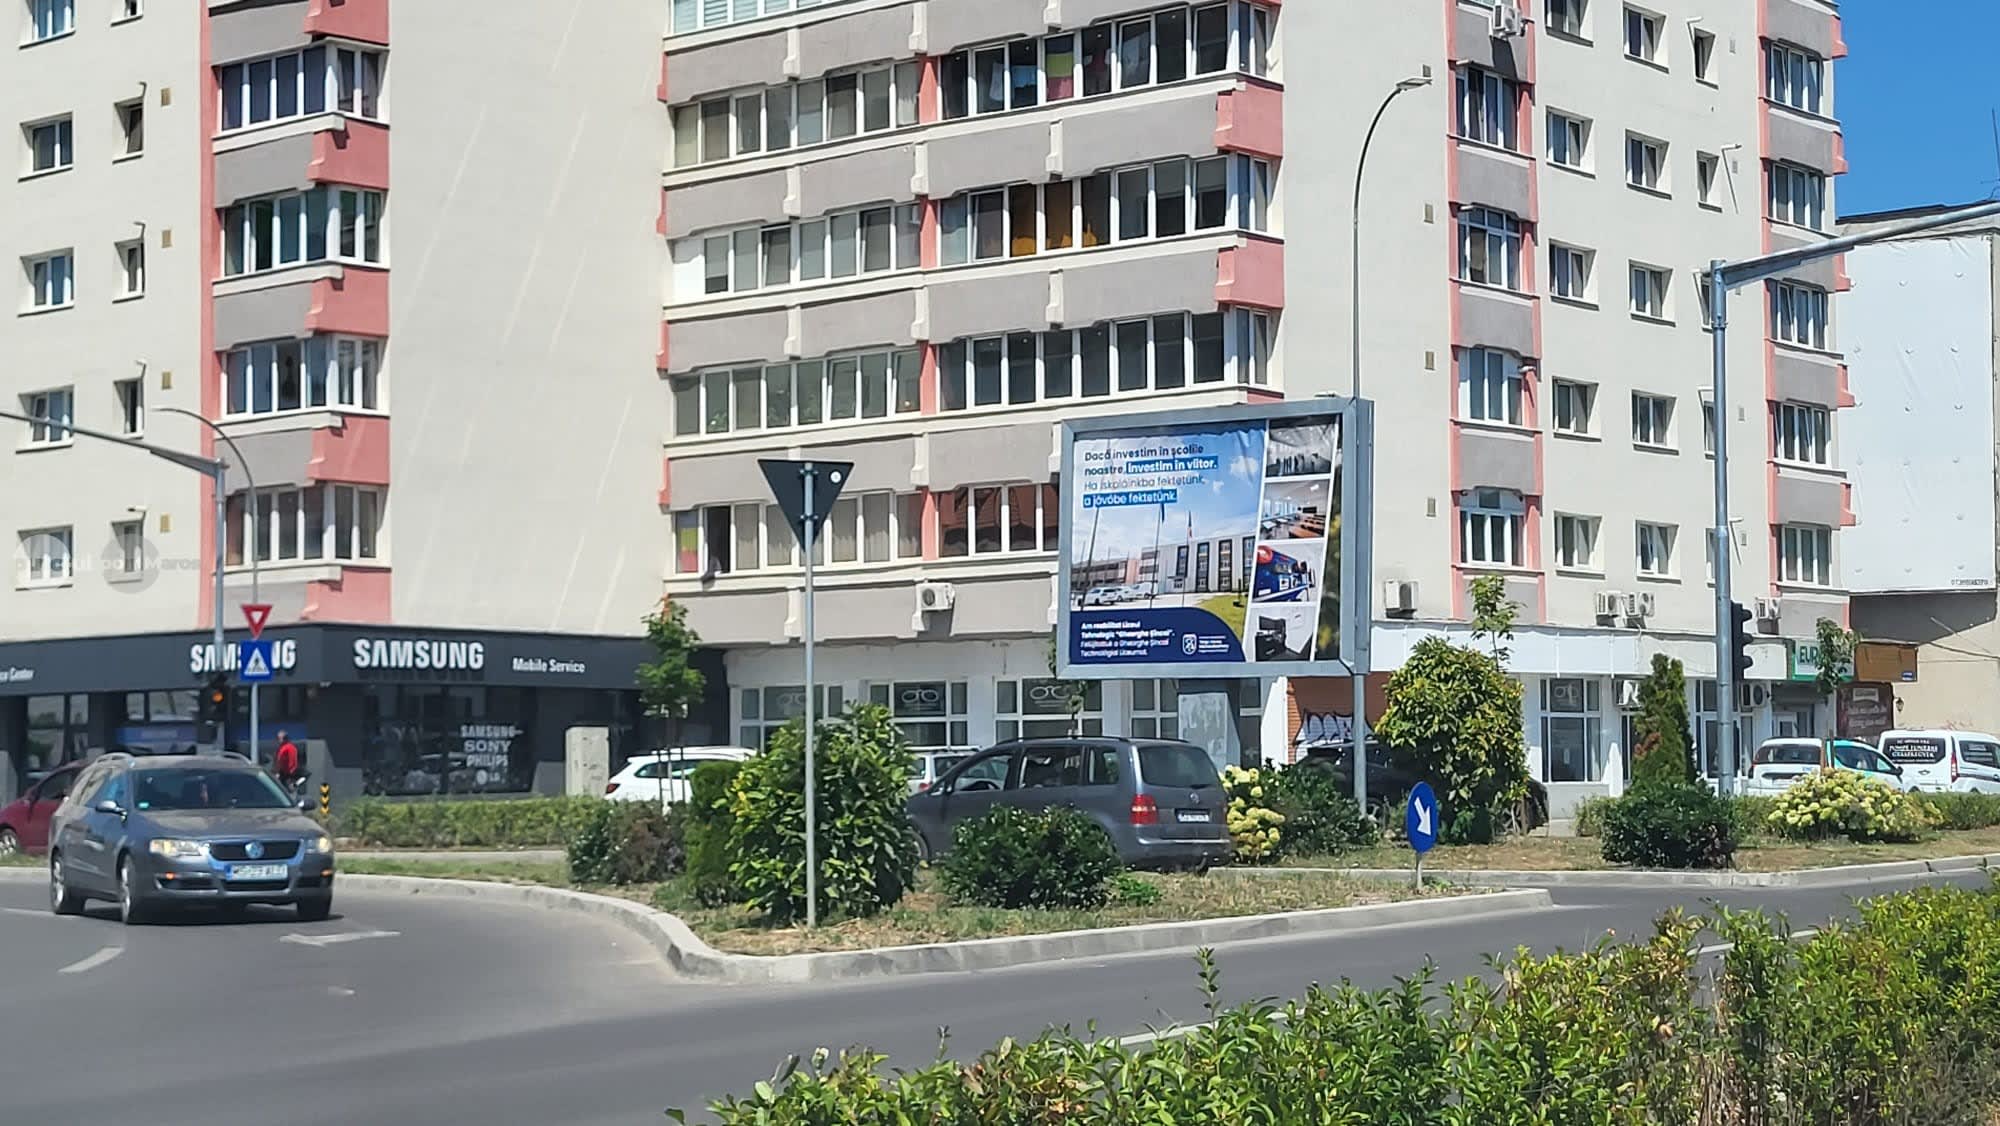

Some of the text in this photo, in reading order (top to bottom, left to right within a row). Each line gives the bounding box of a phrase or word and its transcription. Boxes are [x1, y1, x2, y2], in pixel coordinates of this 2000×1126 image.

[1112, 446, 1157, 458] investim
[1084, 498, 1092, 506] a
[190, 639, 296, 673] SAMNG
[353, 638, 484, 670] SAMSUNG
[513, 657, 585, 674] Mobile Service
[461, 725, 515, 738] SAMSUNG
[464, 740, 511, 752] SONY
